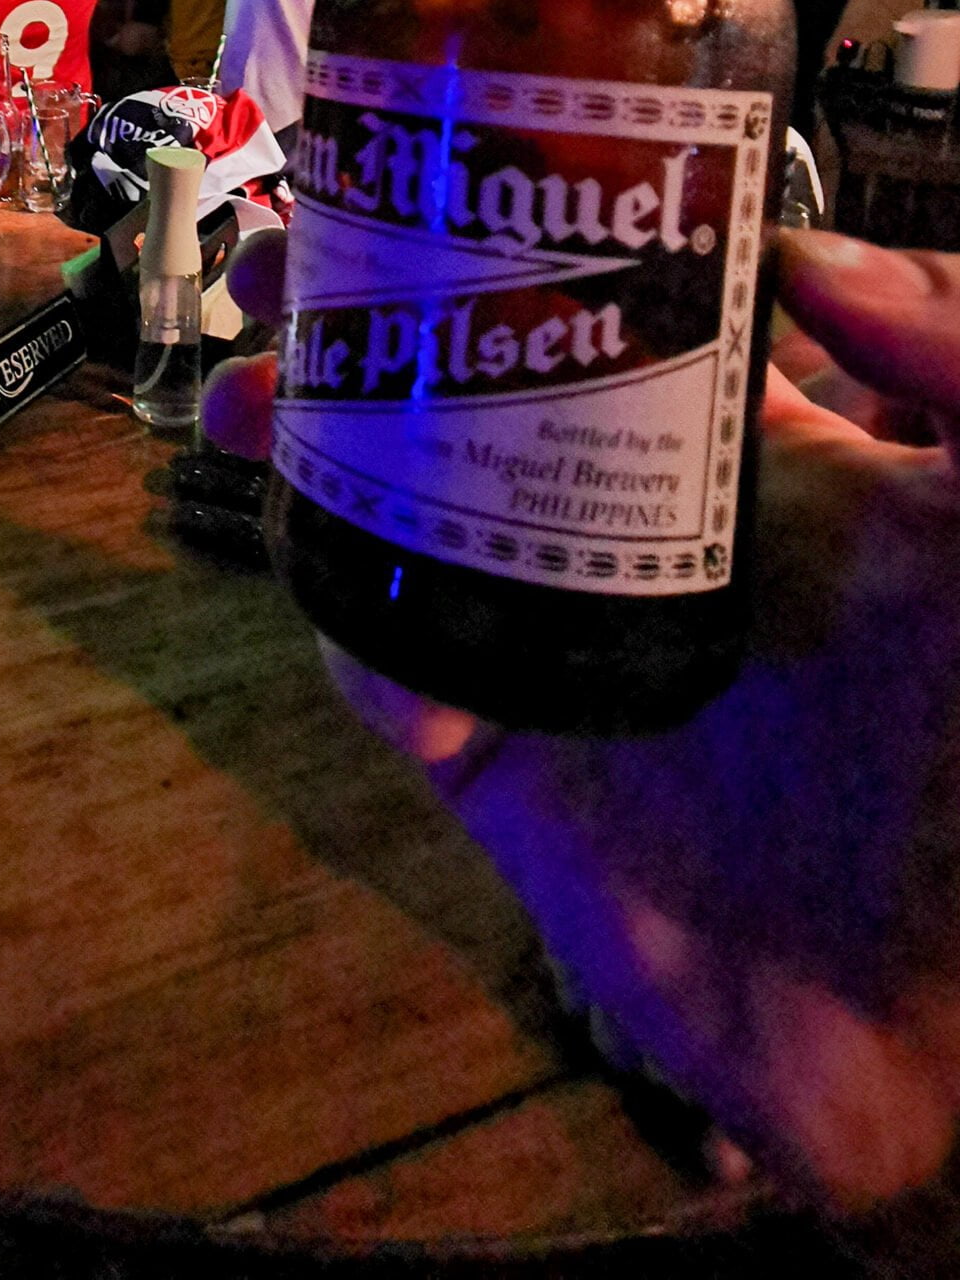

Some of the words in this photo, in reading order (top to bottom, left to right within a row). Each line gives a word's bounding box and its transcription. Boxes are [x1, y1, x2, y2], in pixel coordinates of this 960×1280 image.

[0, 0, 69, 97] 9
[294, 128, 340, 196] an
[342, 111, 689, 255] Miguel
[284, 317, 351, 391] ale
[360, 297, 629, 394] Pilsen
[465, 438, 565, 483] Miguel
[572, 459, 680, 495] Brewery
[510, 487, 678, 527] PHILIPPINES
